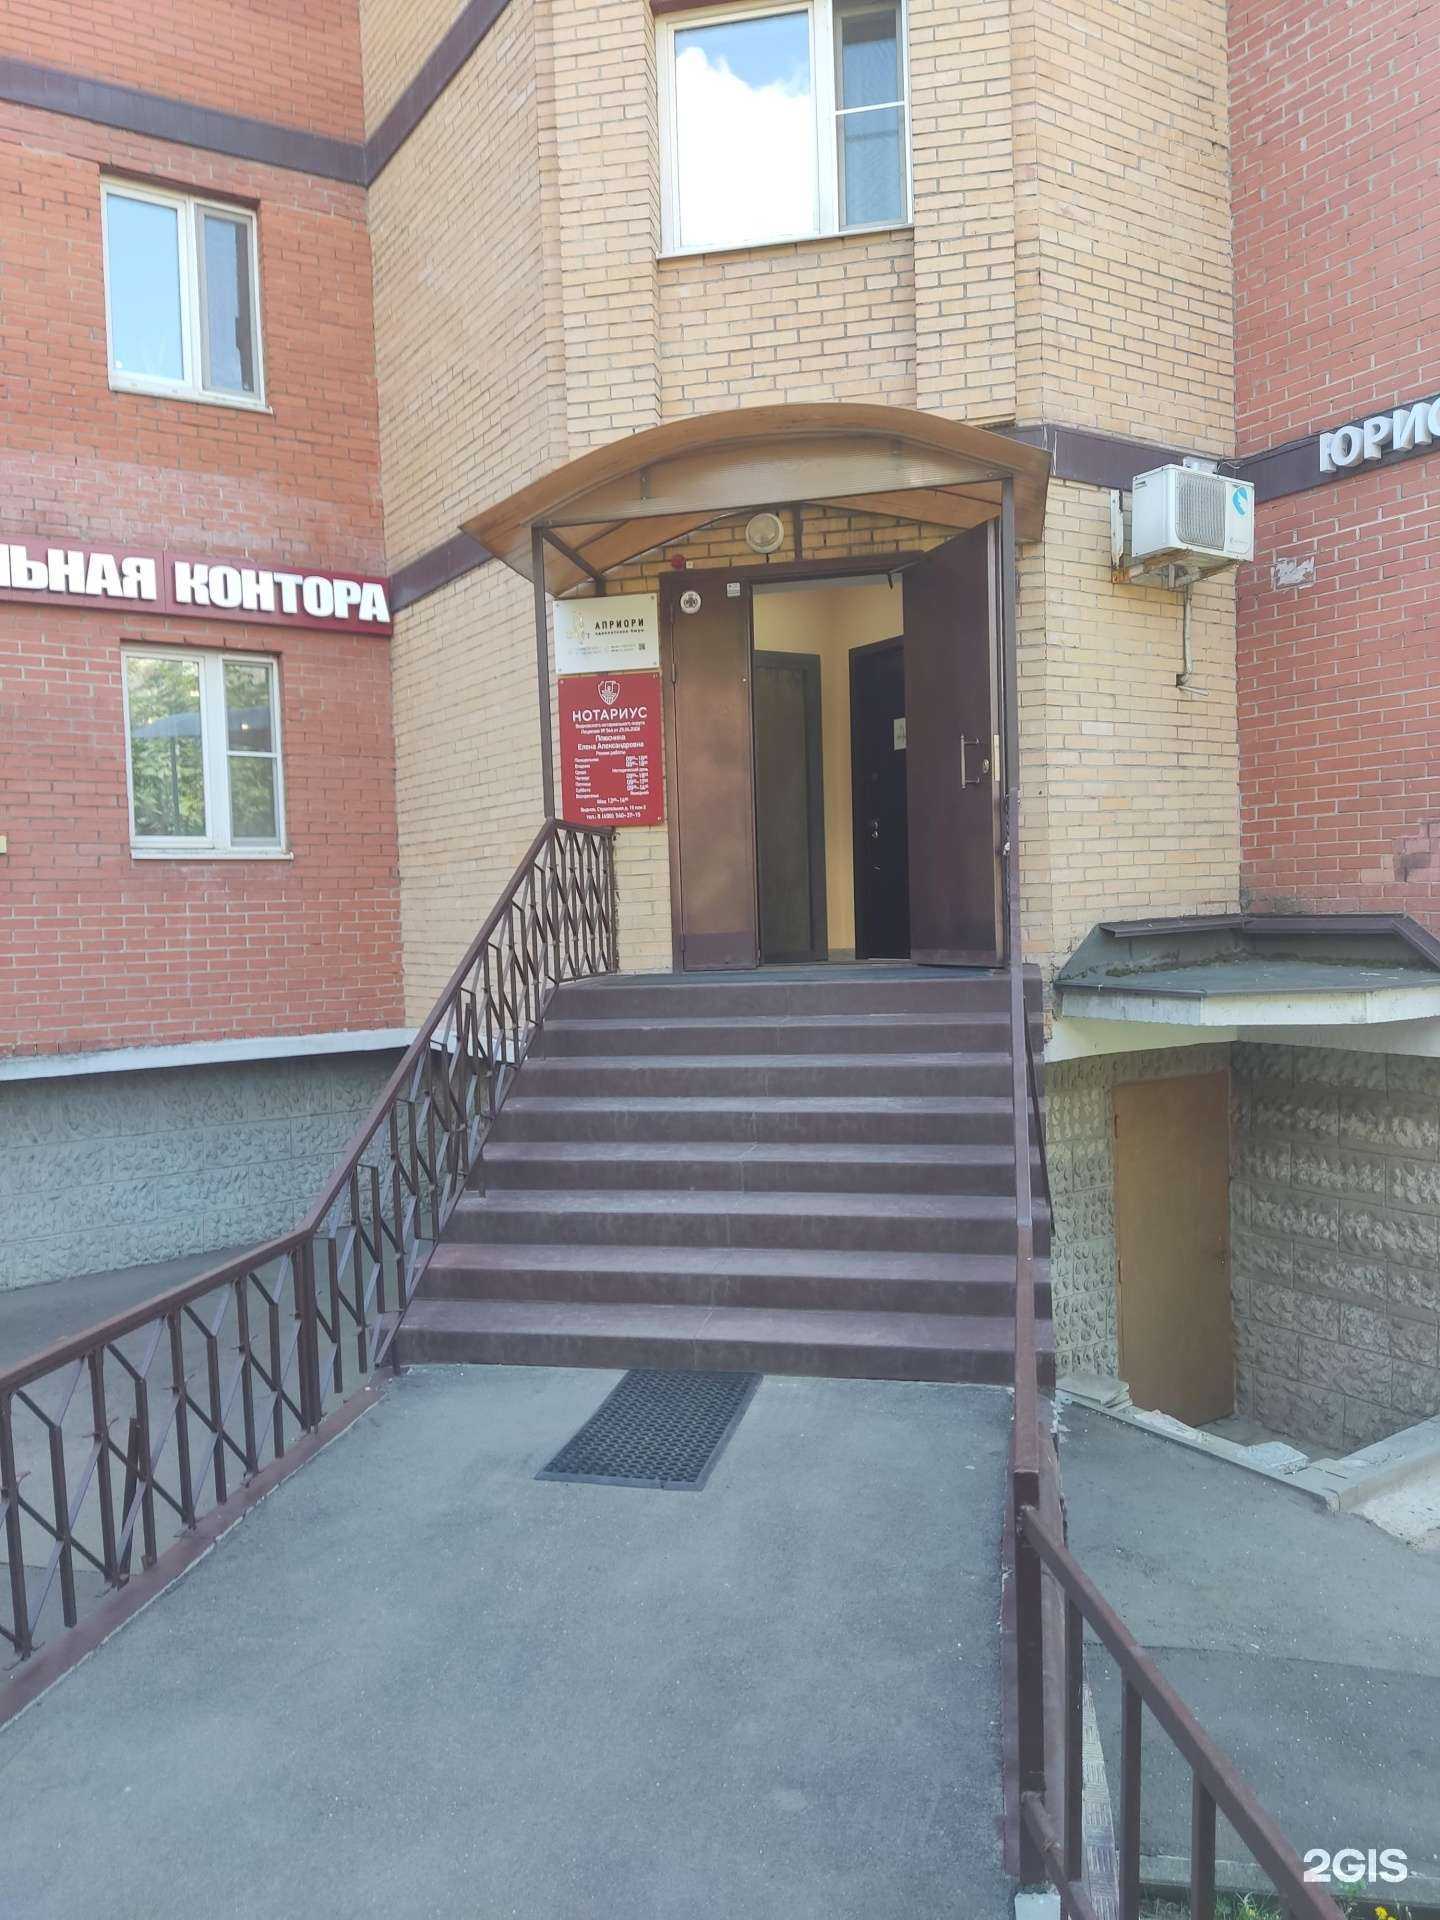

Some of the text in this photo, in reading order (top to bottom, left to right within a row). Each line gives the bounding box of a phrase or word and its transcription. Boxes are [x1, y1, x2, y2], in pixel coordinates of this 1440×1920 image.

[174, 561, 391, 623] КОНТОРА
[595, 618, 644, 630] АПРИОРИ
[572, 706, 648, 722] НОТАРИУС
